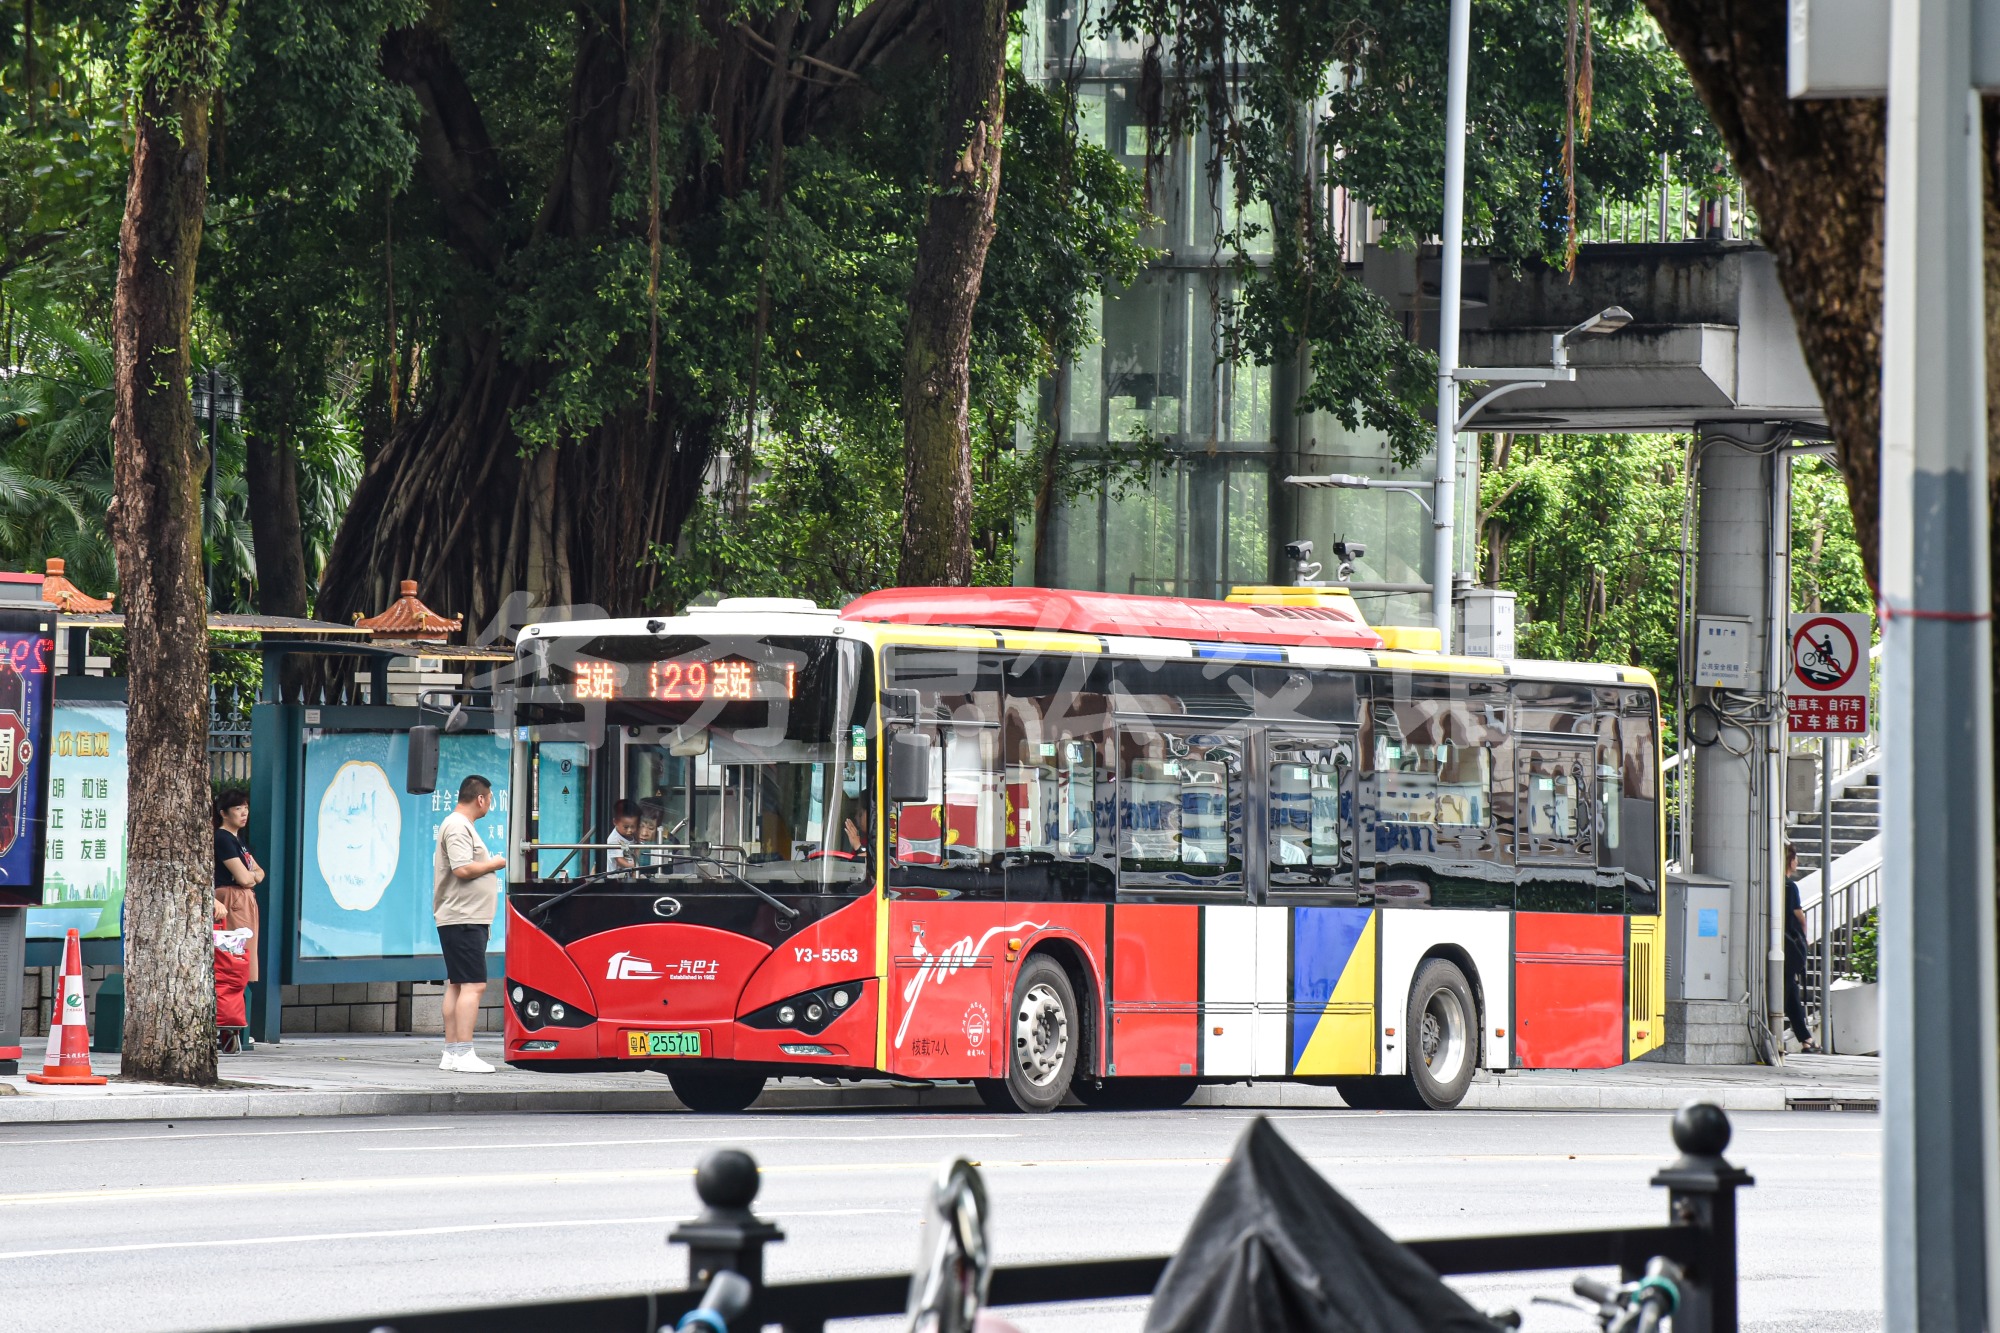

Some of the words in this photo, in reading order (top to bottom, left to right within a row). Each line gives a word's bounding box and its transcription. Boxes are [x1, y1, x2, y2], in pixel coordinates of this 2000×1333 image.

[576, 662, 613, 699] 总站
[713, 661, 751, 699] 总站
[1787, 698, 1861, 711] 电瓶车、自行车
[1789, 714, 1859, 730] 下车推行
[82, 778, 108, 799] 和谐
[81, 808, 107, 829] 法治
[81, 839, 107, 860] 友善
[794, 947, 858, 962] Y3-5563
[666, 960, 719, 974] 一汽巴士
[912, 1038, 949, 1056] 核载74人
